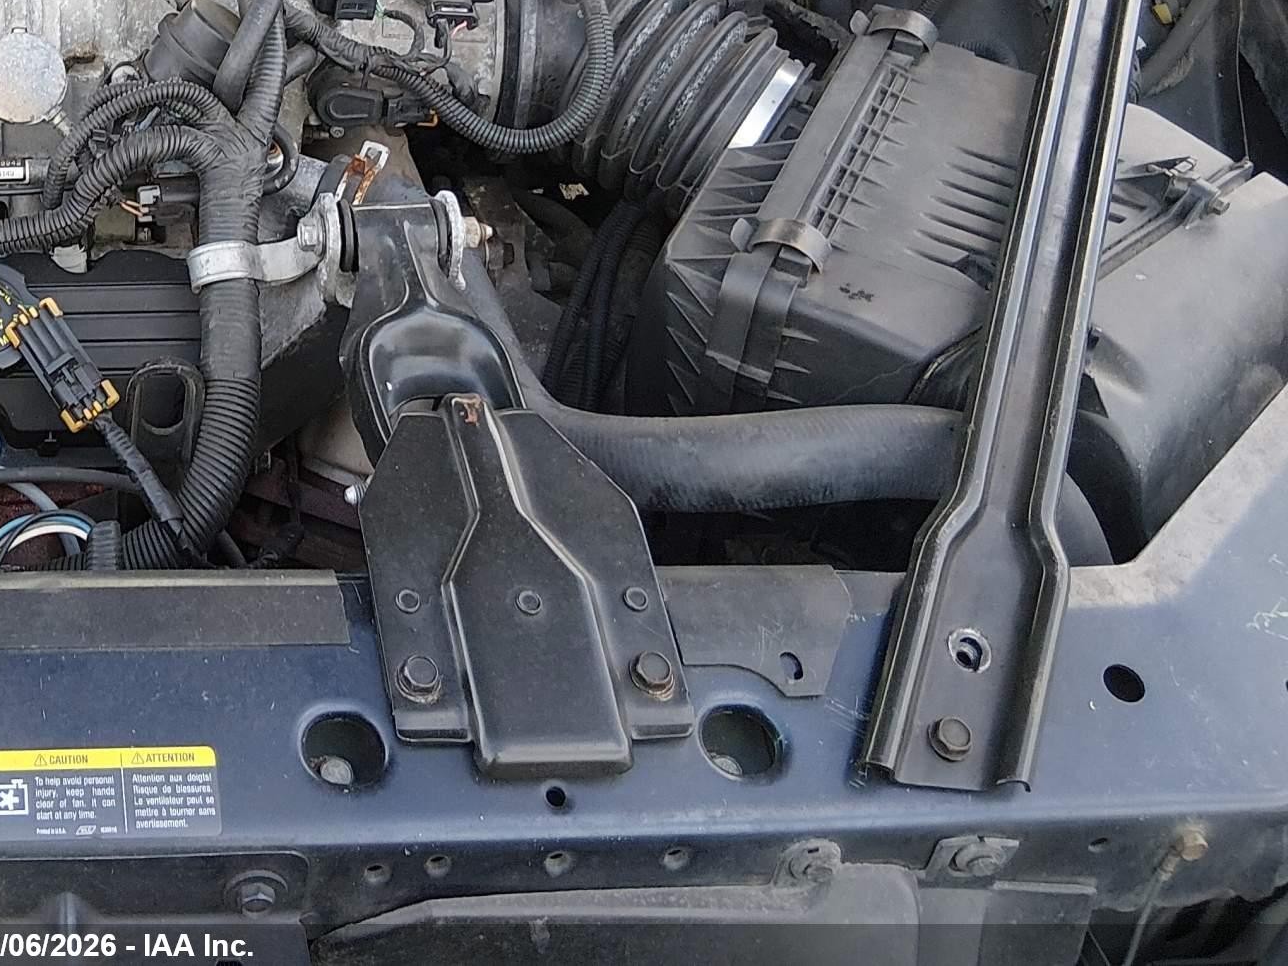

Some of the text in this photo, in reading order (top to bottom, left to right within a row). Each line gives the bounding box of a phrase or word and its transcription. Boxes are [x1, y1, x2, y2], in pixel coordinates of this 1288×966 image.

[49, 755, 88, 765] CAUTION
[146, 752, 195, 763] ATTENTION
[35, 775, 115, 787] To help avoid personal
[132, 773, 165, 783] Attention
[169, 774, 182, 782] aux
[66, 787, 85, 798] keep
[92, 786, 115, 796] hands
[133, 784, 213, 795] Risque de blessures.
[35, 799, 54, 809] clear
[60, 799, 67, 808] of
[73, 799, 87, 808] fan.
[102, 798, 116, 808] can
[134, 795, 215, 806] Le ventilateur peut se
[36, 810, 97, 822] start at any time.
[135, 808, 158, 817] mettre
[169, 807, 196, 817] tourner
[199, 807, 216, 816] sans
[135, 819, 189, 829] avertissement.
